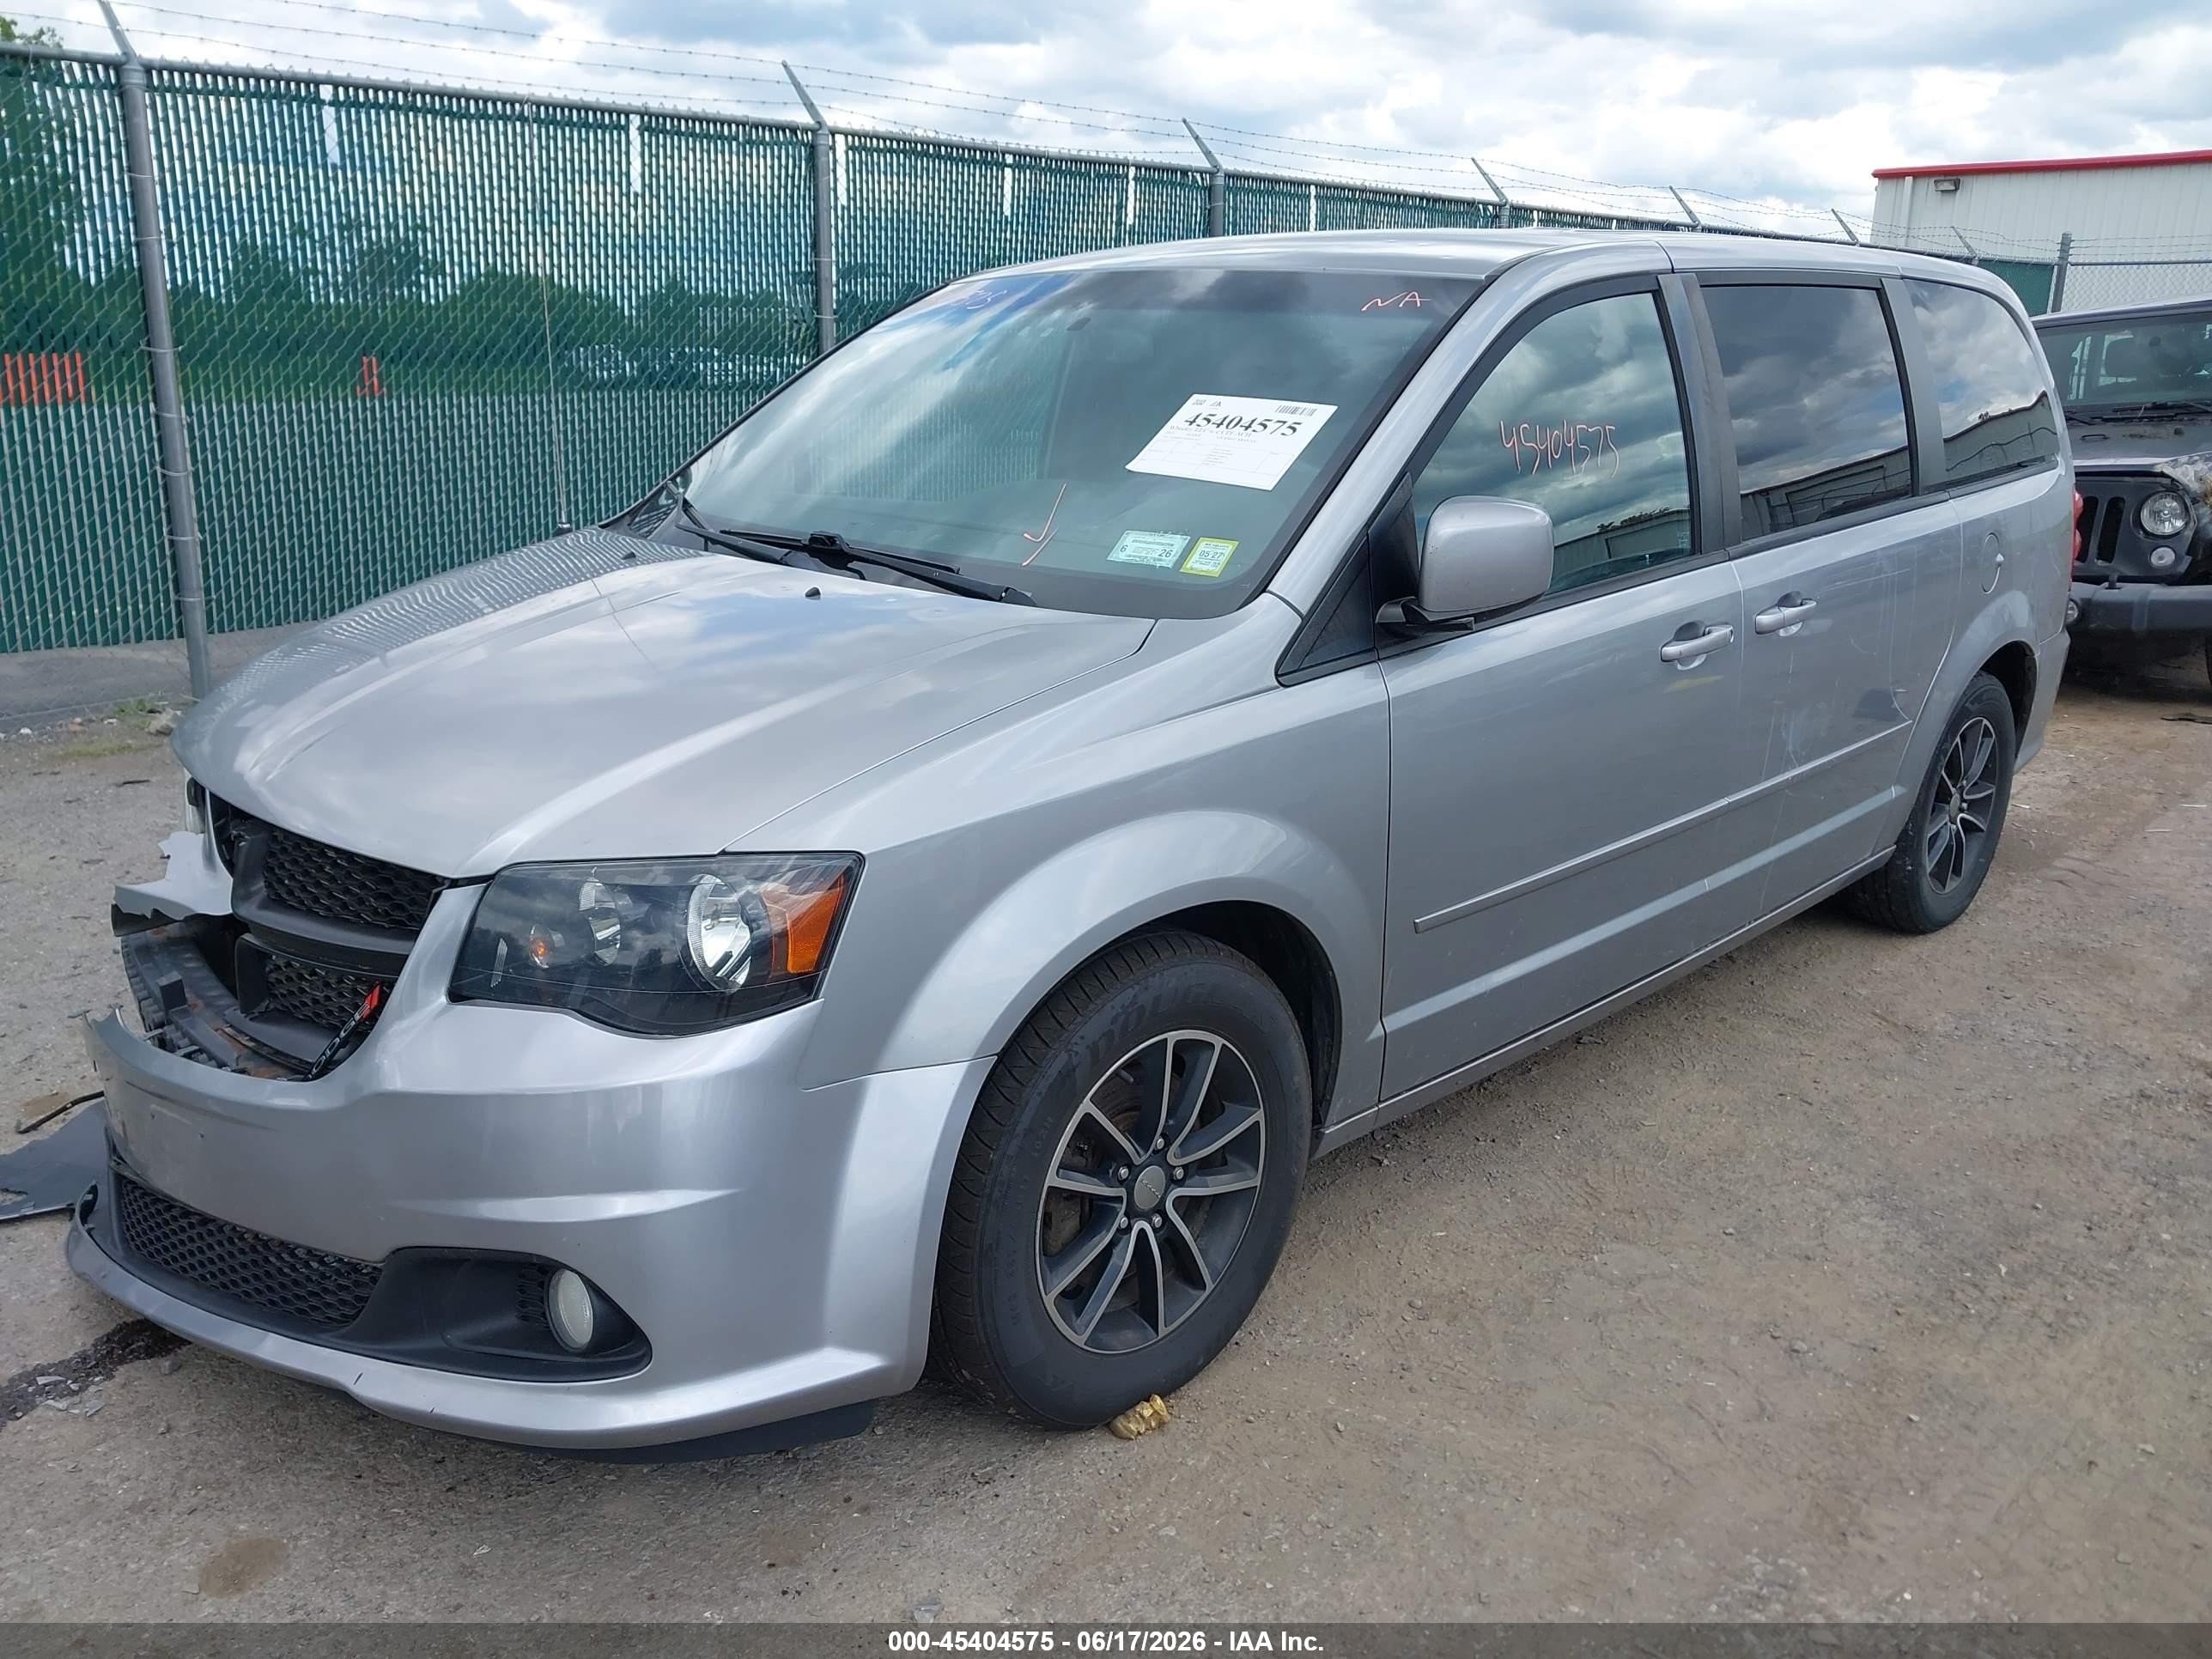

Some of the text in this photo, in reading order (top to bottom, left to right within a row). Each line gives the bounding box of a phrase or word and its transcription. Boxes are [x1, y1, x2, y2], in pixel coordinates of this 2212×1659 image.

[1184, 412, 1304, 437] 45404575
[1499, 419, 1620, 478] 45404575
[1158, 549, 1174, 558] 26
[308, 1002, 370, 1079] ODGE
